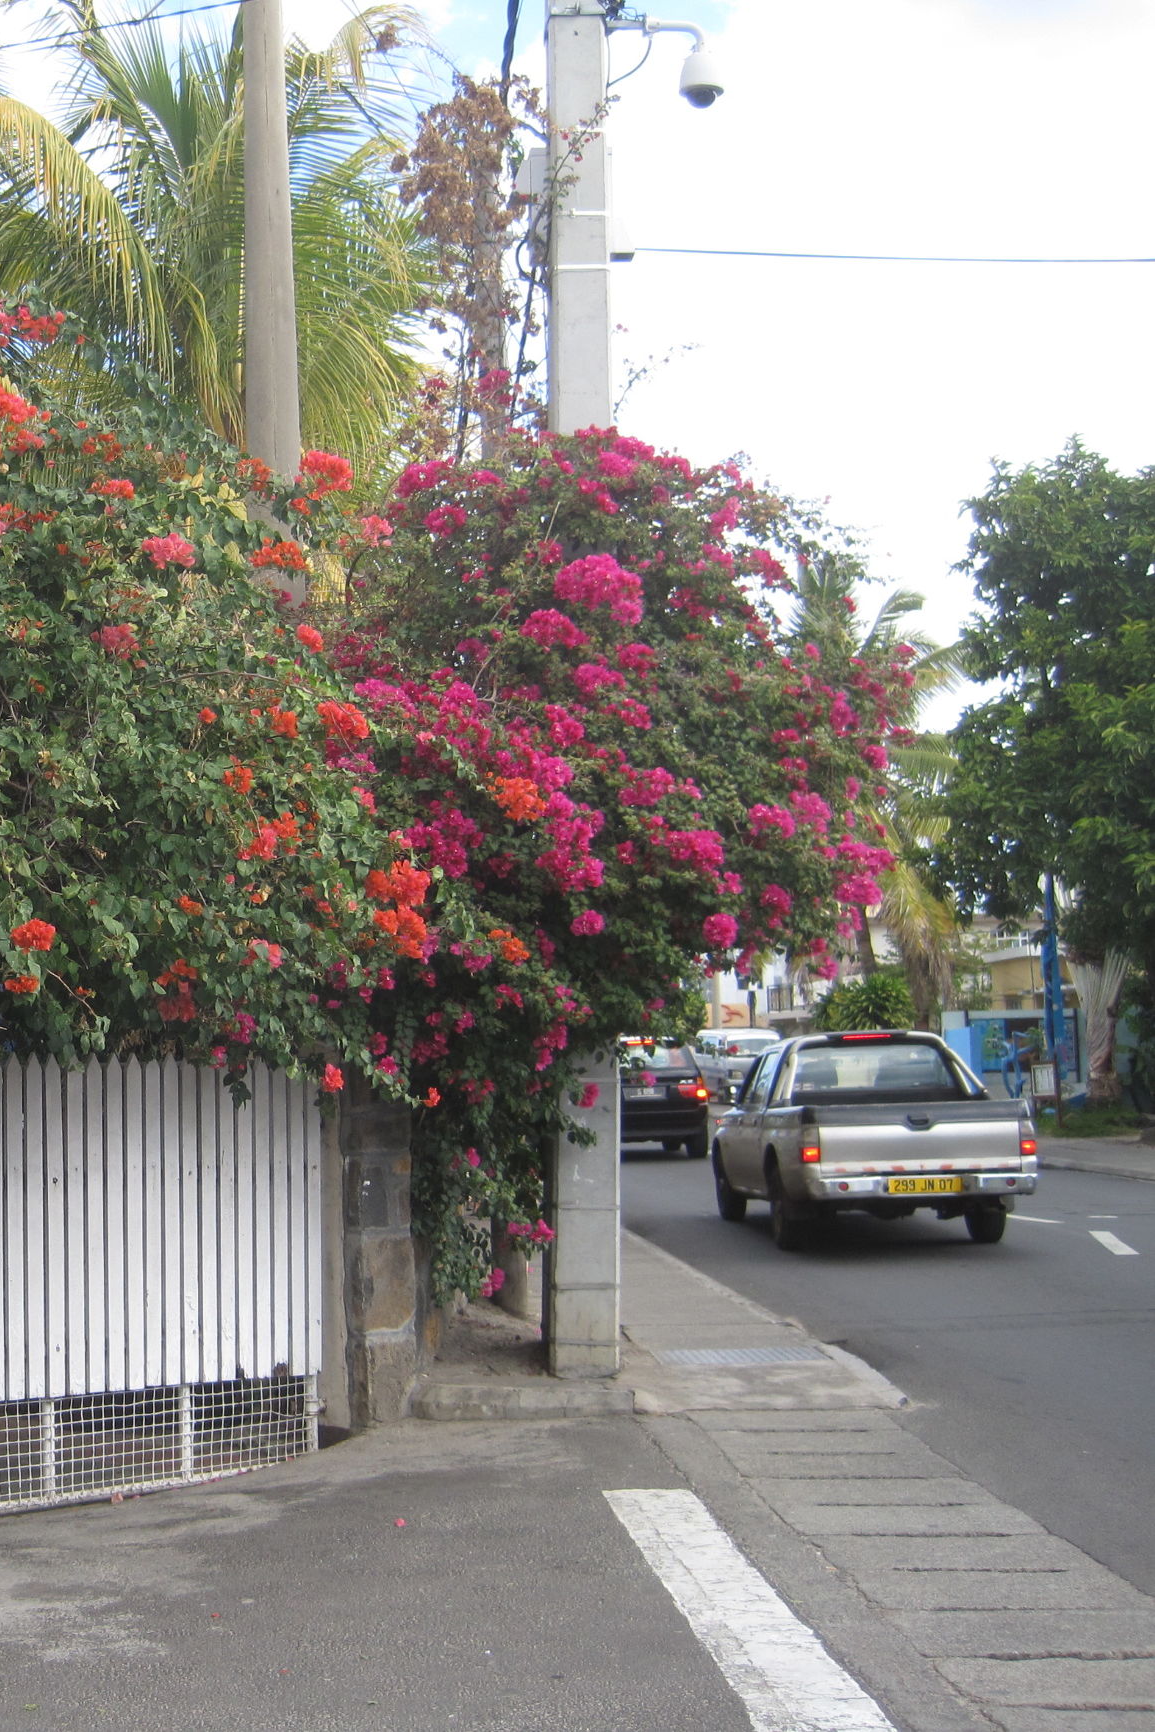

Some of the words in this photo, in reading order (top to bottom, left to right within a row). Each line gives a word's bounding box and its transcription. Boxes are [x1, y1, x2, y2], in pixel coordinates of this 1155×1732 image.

[894, 1180, 915, 1192] 299
[921, 1179, 935, 1191] JN
[939, 1179, 953, 1190] 07
